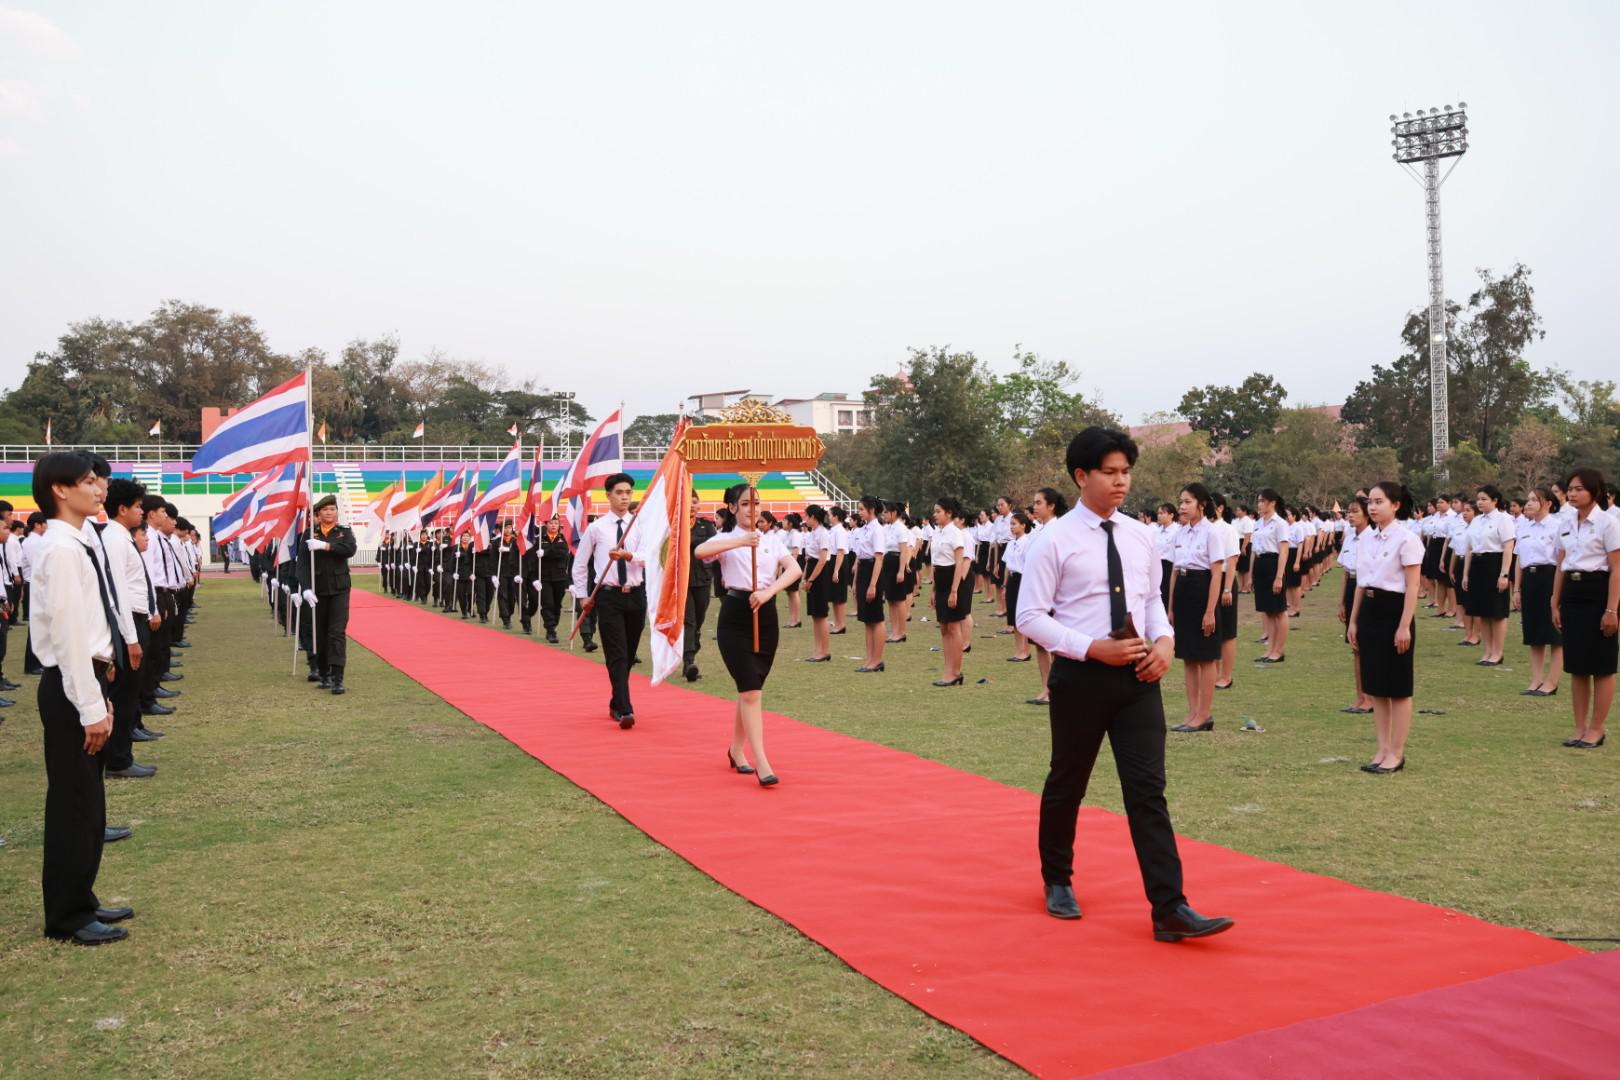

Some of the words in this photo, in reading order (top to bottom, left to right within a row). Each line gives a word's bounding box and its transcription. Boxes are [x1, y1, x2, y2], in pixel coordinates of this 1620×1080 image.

[686, 431, 816, 465] มหาวิทยาลัยราชภัฏกำแพงเพชร
